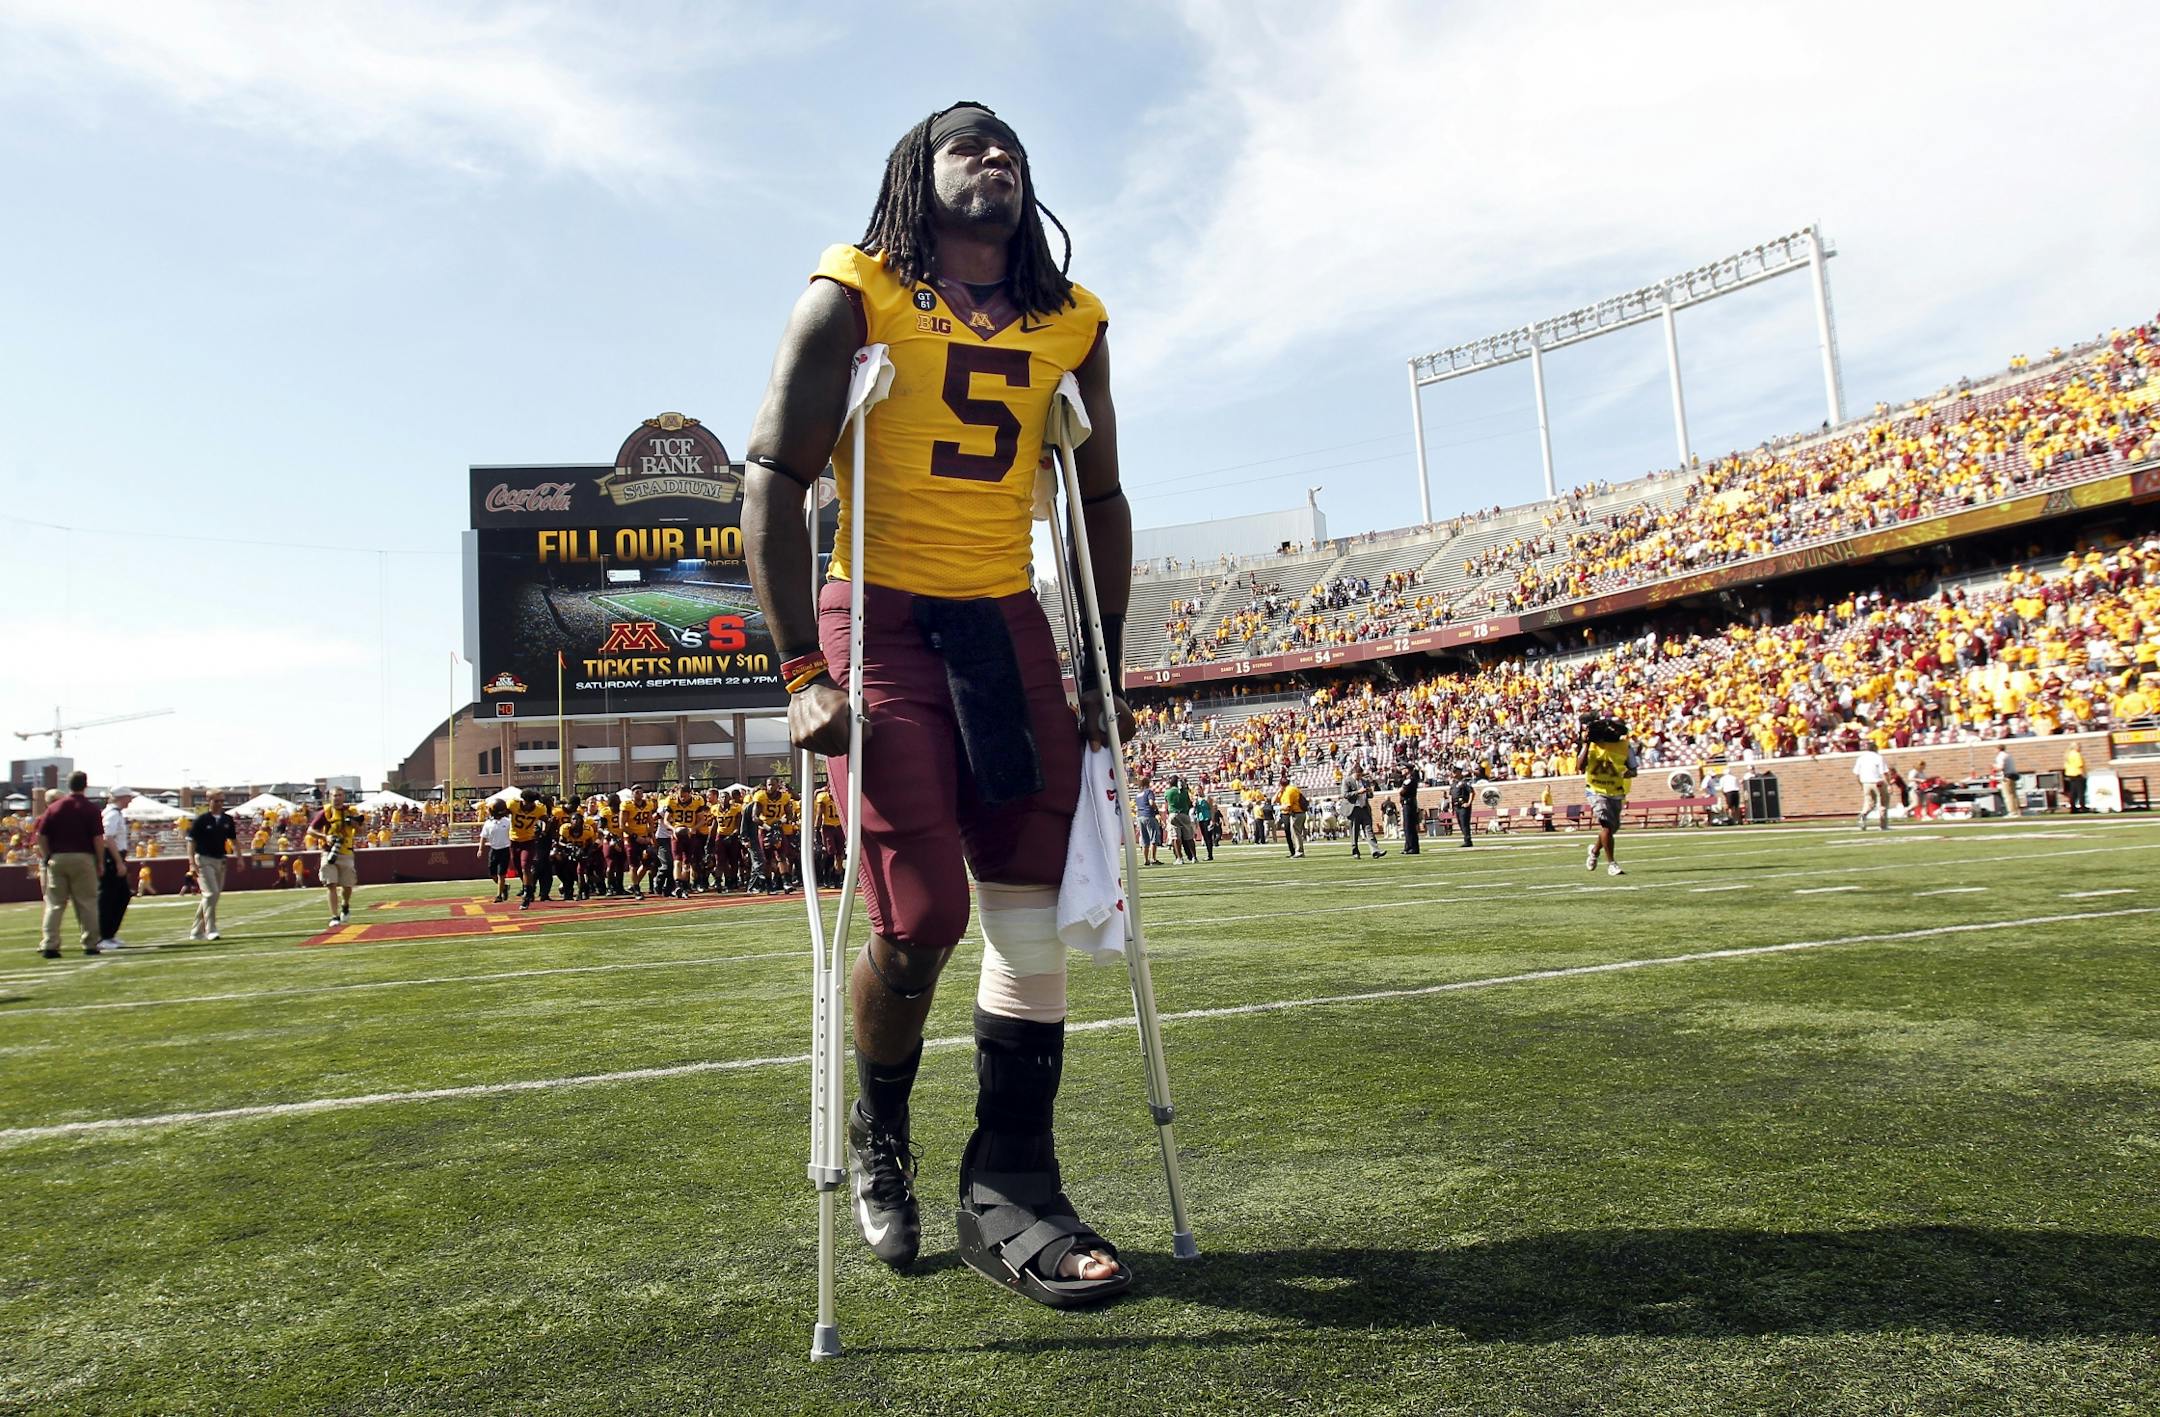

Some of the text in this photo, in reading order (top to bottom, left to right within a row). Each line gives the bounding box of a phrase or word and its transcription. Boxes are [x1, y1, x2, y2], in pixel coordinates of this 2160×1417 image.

[920, 301, 930, 309] 61
[930, 341, 1033, 483] 5
[650, 438, 694, 457] TCF
[640, 456, 704, 475] BANK
[485, 482, 576, 512] Coca-Cola
[623, 479, 723, 501] STADIUM
[538, 529, 601, 563] FILL
[615, 527, 685, 561] OUR
[708, 614, 747, 651] S
[1473, 623, 1488, 638] 78
[1394, 638, 1410, 652] 72
[1315, 651, 1331, 664] 54
[583, 653, 769, 678] TICKETS ONLY $10
[1235, 661, 1250, 674] 15
[575, 680, 643, 690] SATURDAY,
[646, 676, 722, 688] SEPTEMBER
[725, 676, 740, 686] 22
[753, 675, 778, 685] 7PM
[1156, 670, 1170, 682] 10
[499, 704, 512, 714] 40
[633, 811, 649, 824] 48
[674, 810, 694, 823] 38
[767, 804, 782, 818] 51
[514, 814, 536, 830] 57
